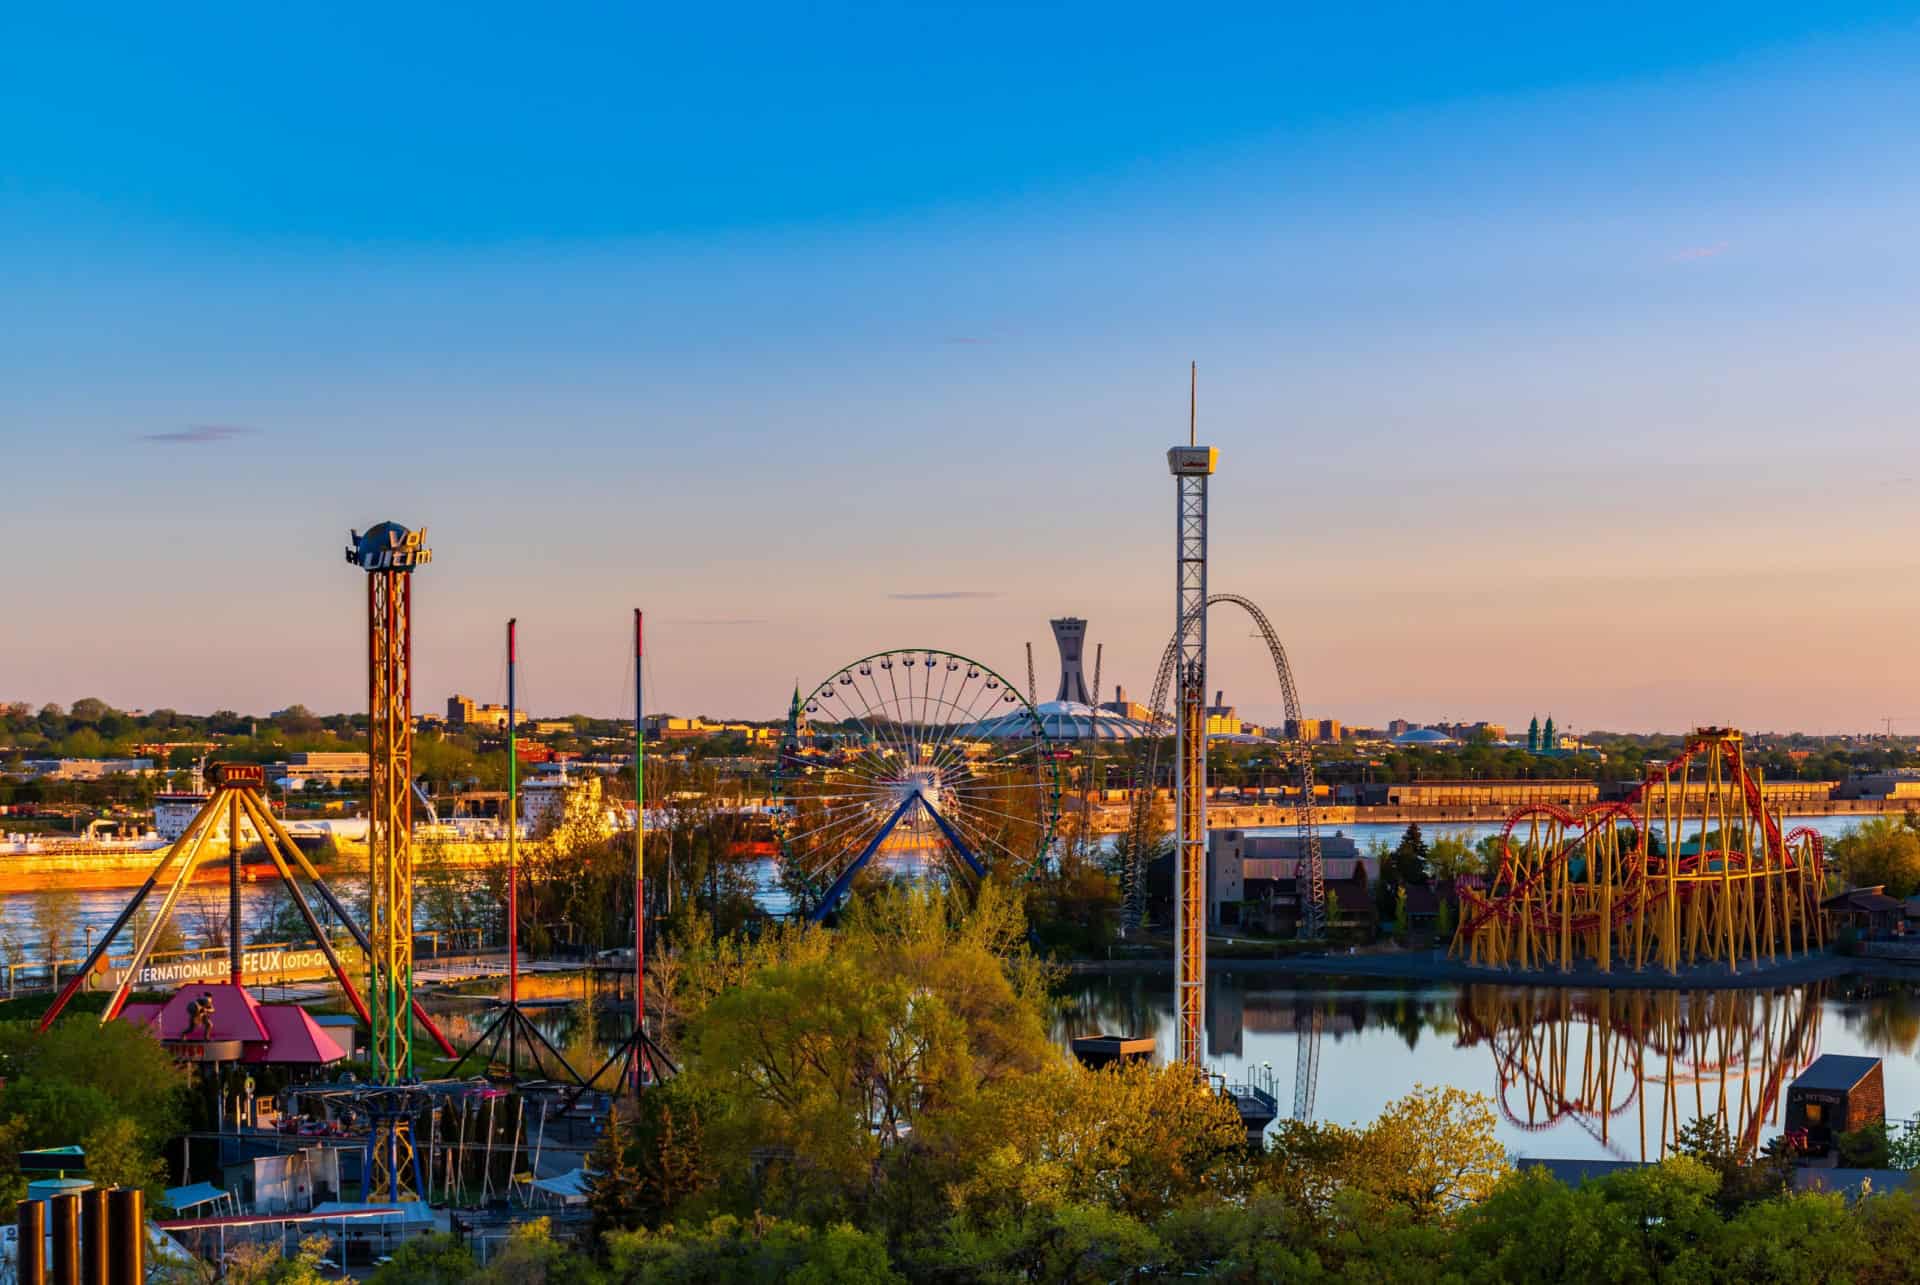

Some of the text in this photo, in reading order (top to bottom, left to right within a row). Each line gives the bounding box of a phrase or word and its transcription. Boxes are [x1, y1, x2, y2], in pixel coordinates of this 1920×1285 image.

[389, 528, 428, 548] Vol
[364, 546, 432, 569] Ultim
[224, 766, 263, 781] TITAN
[116, 961, 214, 985] L'TERNATIONAL
[218, 960, 232, 976] DE
[242, 951, 281, 973] FEUX
